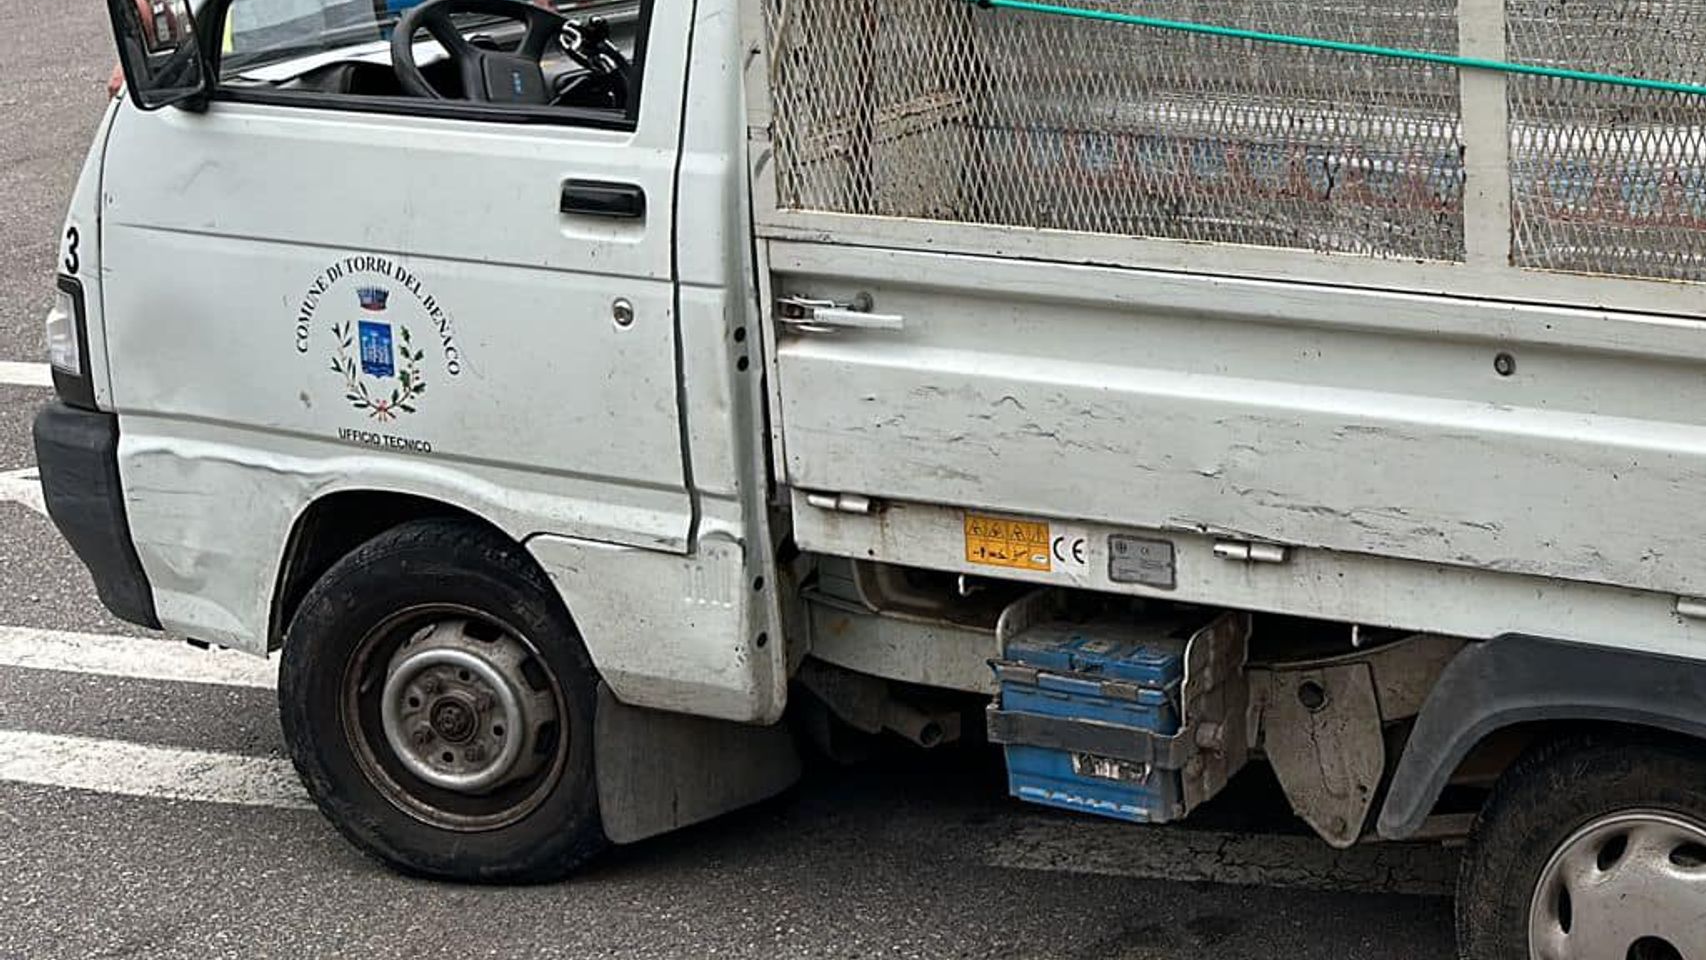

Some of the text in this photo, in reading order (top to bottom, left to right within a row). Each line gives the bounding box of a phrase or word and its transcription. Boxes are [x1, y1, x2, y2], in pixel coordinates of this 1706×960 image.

[65, 227, 79, 274] 3
[296, 256, 460, 375] COMUNE DI TORRI DEL BENACO
[339, 427, 431, 453] UFFICIO TECNICO
